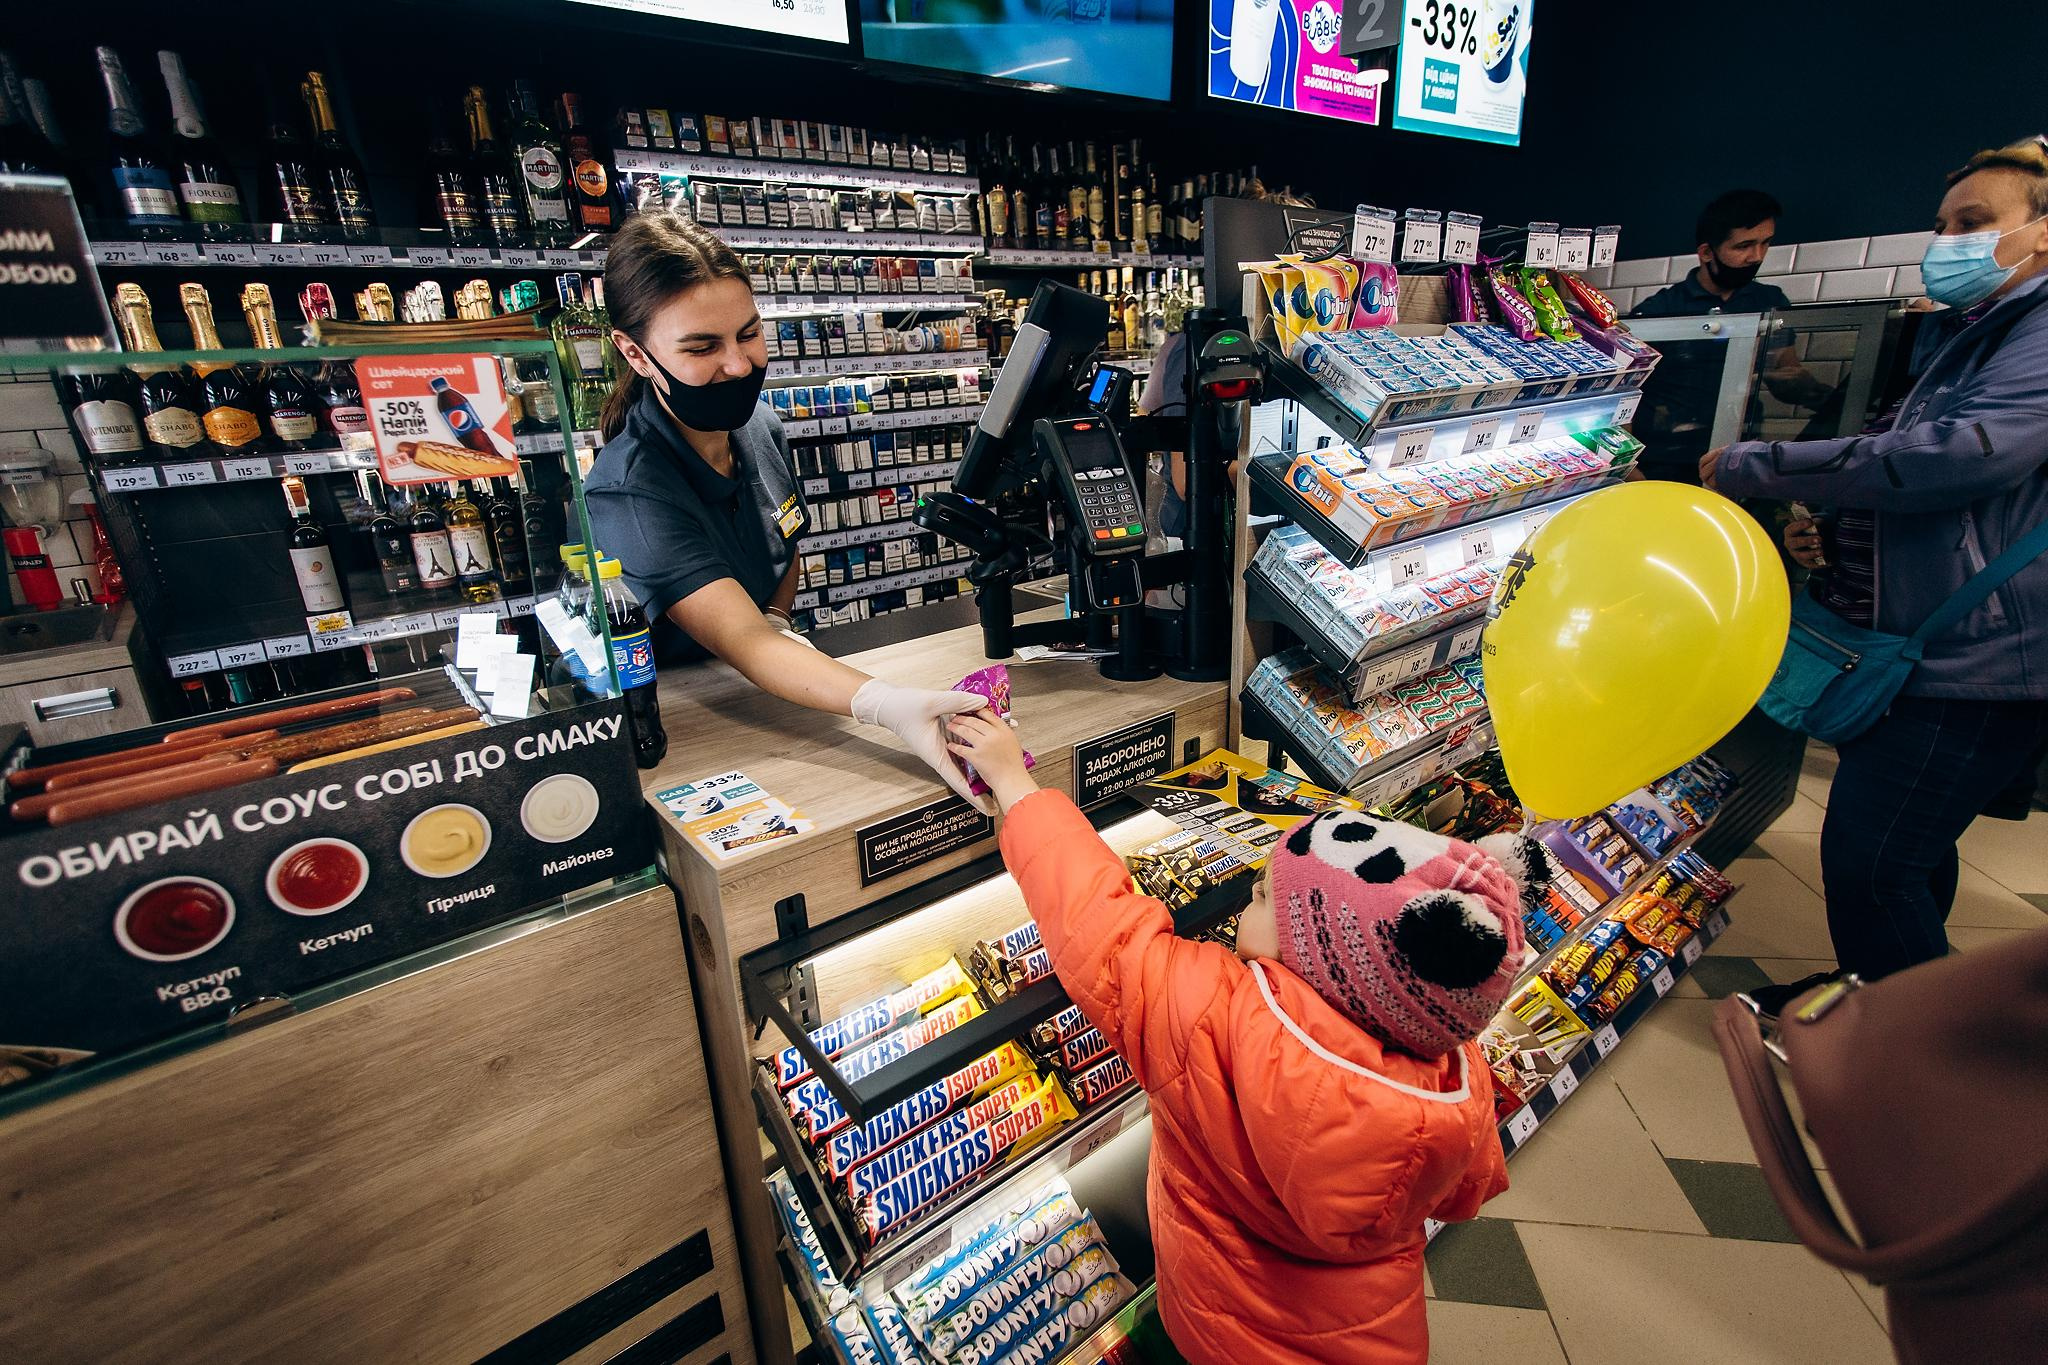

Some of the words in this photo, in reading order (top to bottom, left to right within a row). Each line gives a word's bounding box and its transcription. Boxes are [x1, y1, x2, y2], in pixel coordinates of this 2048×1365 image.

[1355, 0, 1385, 42] 2
[1411, 0, 1478, 56] -33%
[526, 164, 559, 173] MARTINI
[1365, 235, 1379, 252] 27
[1413, 239, 1425, 254] 27
[1455, 240, 1466, 255] 27
[104, 252, 127, 261] 271
[157, 252, 179, 262] 168
[214, 253, 236, 262] 140
[269, 253, 285, 263] 76
[314, 254, 330, 263] 117
[361, 254, 376, 263] 117
[417, 255, 434, 264] 109
[461, 256, 477, 265] 109
[508, 256, 524, 265] 109
[551, 257, 567, 265] 280
[1536, 247, 1545, 261] 16
[1567, 250, 1576, 263] 16
[1600, 248, 1607, 261] 16
[367, 364, 465, 379] Швейцарський
[1303, 344, 1346, 389] Orbit
[371, 379, 394, 390] сет
[378, 401, 424, 416] -50%
[159, 423, 196, 433] SHABO
[212, 420, 248, 431] SHABO
[380, 414, 428, 430] Напій
[384, 428, 407, 438] Pepsi
[1521, 425, 1531, 437] 14
[1475, 433, 1484, 447] 14
[1405, 445, 1416, 460] 14
[235, 467, 252, 476] 115
[293, 462, 312, 471] 109
[115, 477, 137, 488] 129
[178, 472, 196, 482] 115
[1293, 465, 1335, 507] Orbit
[1473, 543, 1483, 557] 14
[1299, 558, 1318, 571] Dirol
[1403, 563, 1414, 578] 14
[1327, 584, 1347, 597] Dirol
[515, 604, 531, 613] 109
[1394, 599, 1413, 612] Dirol
[442, 616, 458, 626] 138
[1356, 610, 1376, 625] Dirol
[321, 637, 339, 647] 129
[1458, 640, 1468, 653] 14
[274, 644, 292, 655] 197
[228, 653, 247, 664] 197
[178, 661, 199, 672] 227
[1410, 659, 1420, 673] 18
[1375, 674, 1386, 688] 18
[1292, 685, 1312, 700] Dirol
[1320, 710, 1339, 725] Dirol
[1384, 721, 1403, 737] Dirol
[1347, 738, 1367, 755] Dirol
[1085, 733, 1166, 775] ЗАБОРОНЕНО
[1085, 765, 1122, 788] ПРОДАЖ
[1122, 749, 1166, 773] АЛКОГОЛЮ
[658, 786, 694, 800] КАВА
[696, 773, 745, 791] -33%
[1103, 780, 1124, 795] 22:00
[1124, 777, 1134, 787] до
[1135, 767, 1156, 782] 08:00
[1400, 778, 1409, 790] 18
[17, 809, 224, 888] ОБИРАЙ
[230, 781, 349, 834] СОУС
[354, 758, 445, 803] СОБІ
[452, 744, 507, 784] ДО
[513, 713, 623, 762] СМАКУ
[1151, 790, 1200, 808] -33%
[874, 842, 888, 853] МИ
[889, 837, 899, 847] НЕ
[900, 821, 943, 843] ПРОДАЄМО
[874, 844, 909, 861] ОСОБАМ
[909, 829, 950, 851] МОЛОДШЕ
[541, 844, 615, 879] Майонез
[427, 881, 497, 916] Гірчиця
[1647, 906, 1665, 926] LION
[299, 921, 374, 956] Кетчуп
[156, 963, 243, 1004] Кетчуп
[181, 985, 234, 1015] BBQ
[899, 984, 940, 1014] SUPER
[912, 1008, 956, 1048] SUPER
[834, 1080, 948, 1173] SNICKERS
[953, 1054, 999, 1100] SUPER
[999, 1046, 1016, 1067] +1
[1521, 1120, 1528, 1132] 6
[855, 1110, 970, 1197] SNICKERS
[973, 1085, 1019, 1127] SUPER
[875, 1128, 989, 1232] SNICKERS
[996, 1101, 1043, 1147] SUPER
[1044, 1092, 1059, 1116] +1
[923, 1230, 1017, 1316] BOUNTY
[950, 1254, 1044, 1341] BOUNTY
[958, 1280, 1052, 1365] BOUNTY
